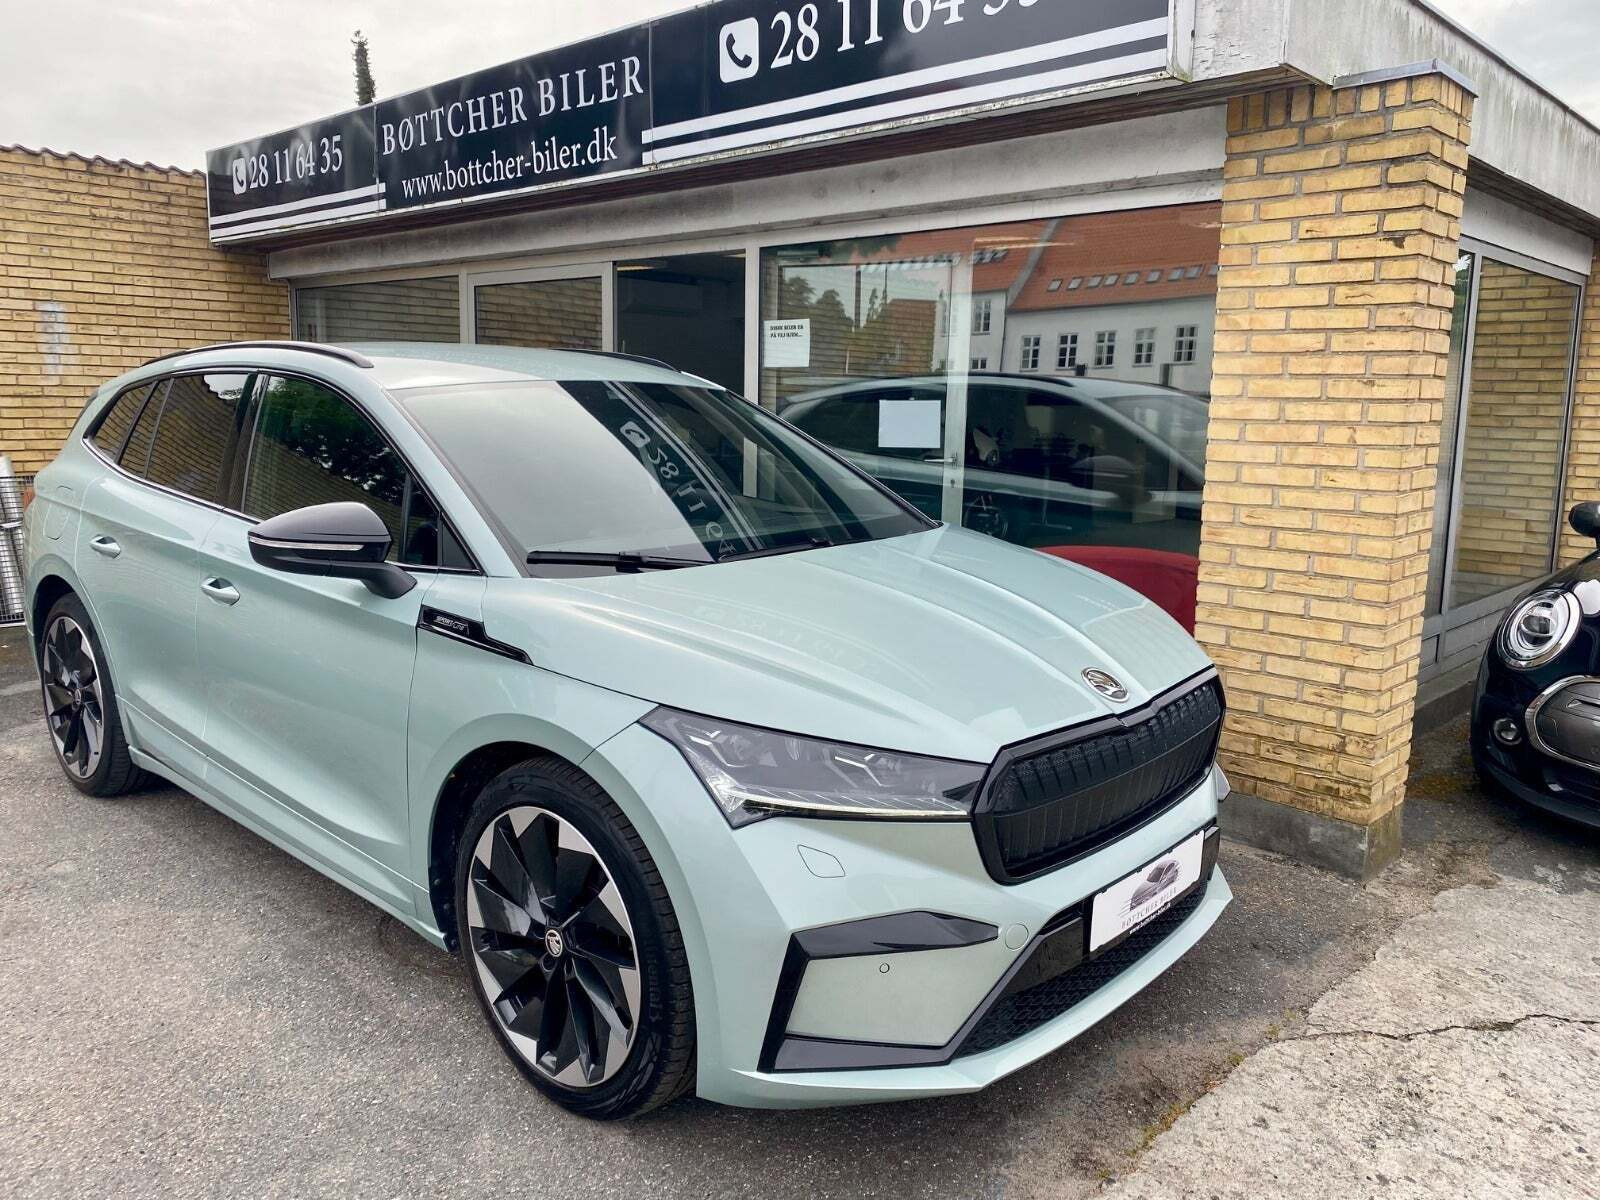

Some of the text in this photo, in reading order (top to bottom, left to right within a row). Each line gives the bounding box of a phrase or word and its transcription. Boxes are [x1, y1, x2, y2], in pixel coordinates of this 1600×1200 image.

[771, 3, 819, 69] 28
[837, 0, 883, 51] 11
[382, 55, 644, 156] BØTTCHER BILER
[249, 134, 343, 189] 28 11 64 35
[401, 125, 618, 199] www.bottcher-biler.dk
